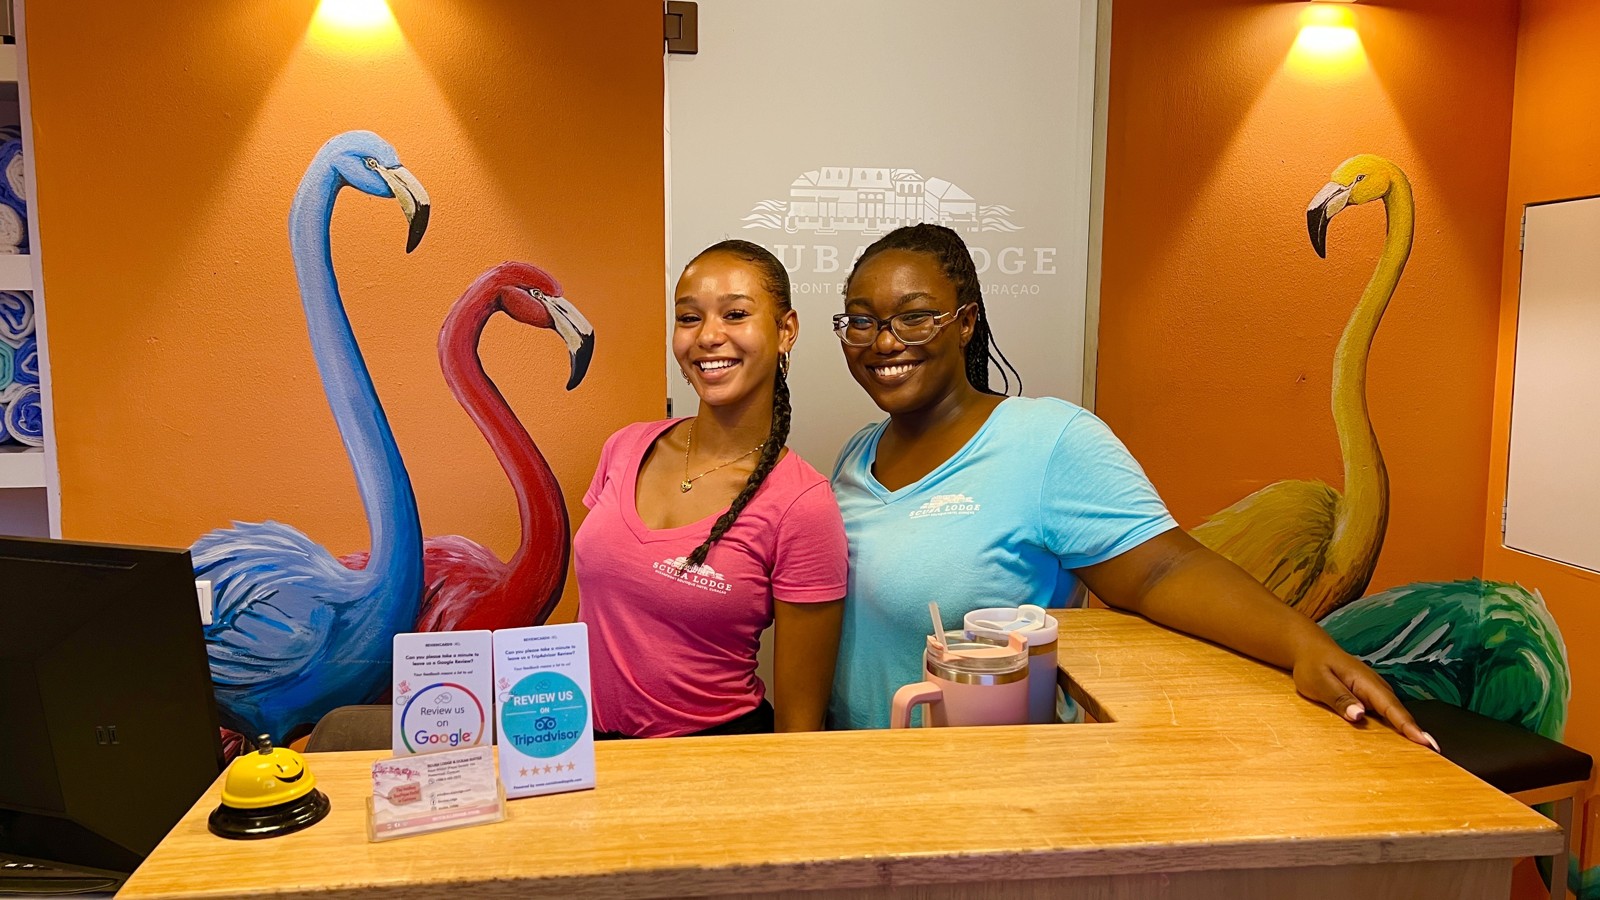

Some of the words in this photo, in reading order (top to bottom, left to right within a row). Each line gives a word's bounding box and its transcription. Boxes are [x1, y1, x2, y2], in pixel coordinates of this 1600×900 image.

[981, 284, 1040, 298] URAÇAO
[945, 504, 981, 512] LODGE
[693, 575, 733, 591] LODGE
[513, 691, 555, 706] REVIEW
[558, 690, 574, 701] US
[420, 706, 452, 715] Review
[414, 728, 471, 747] Google
[513, 730, 579, 746] Tripadvisor
